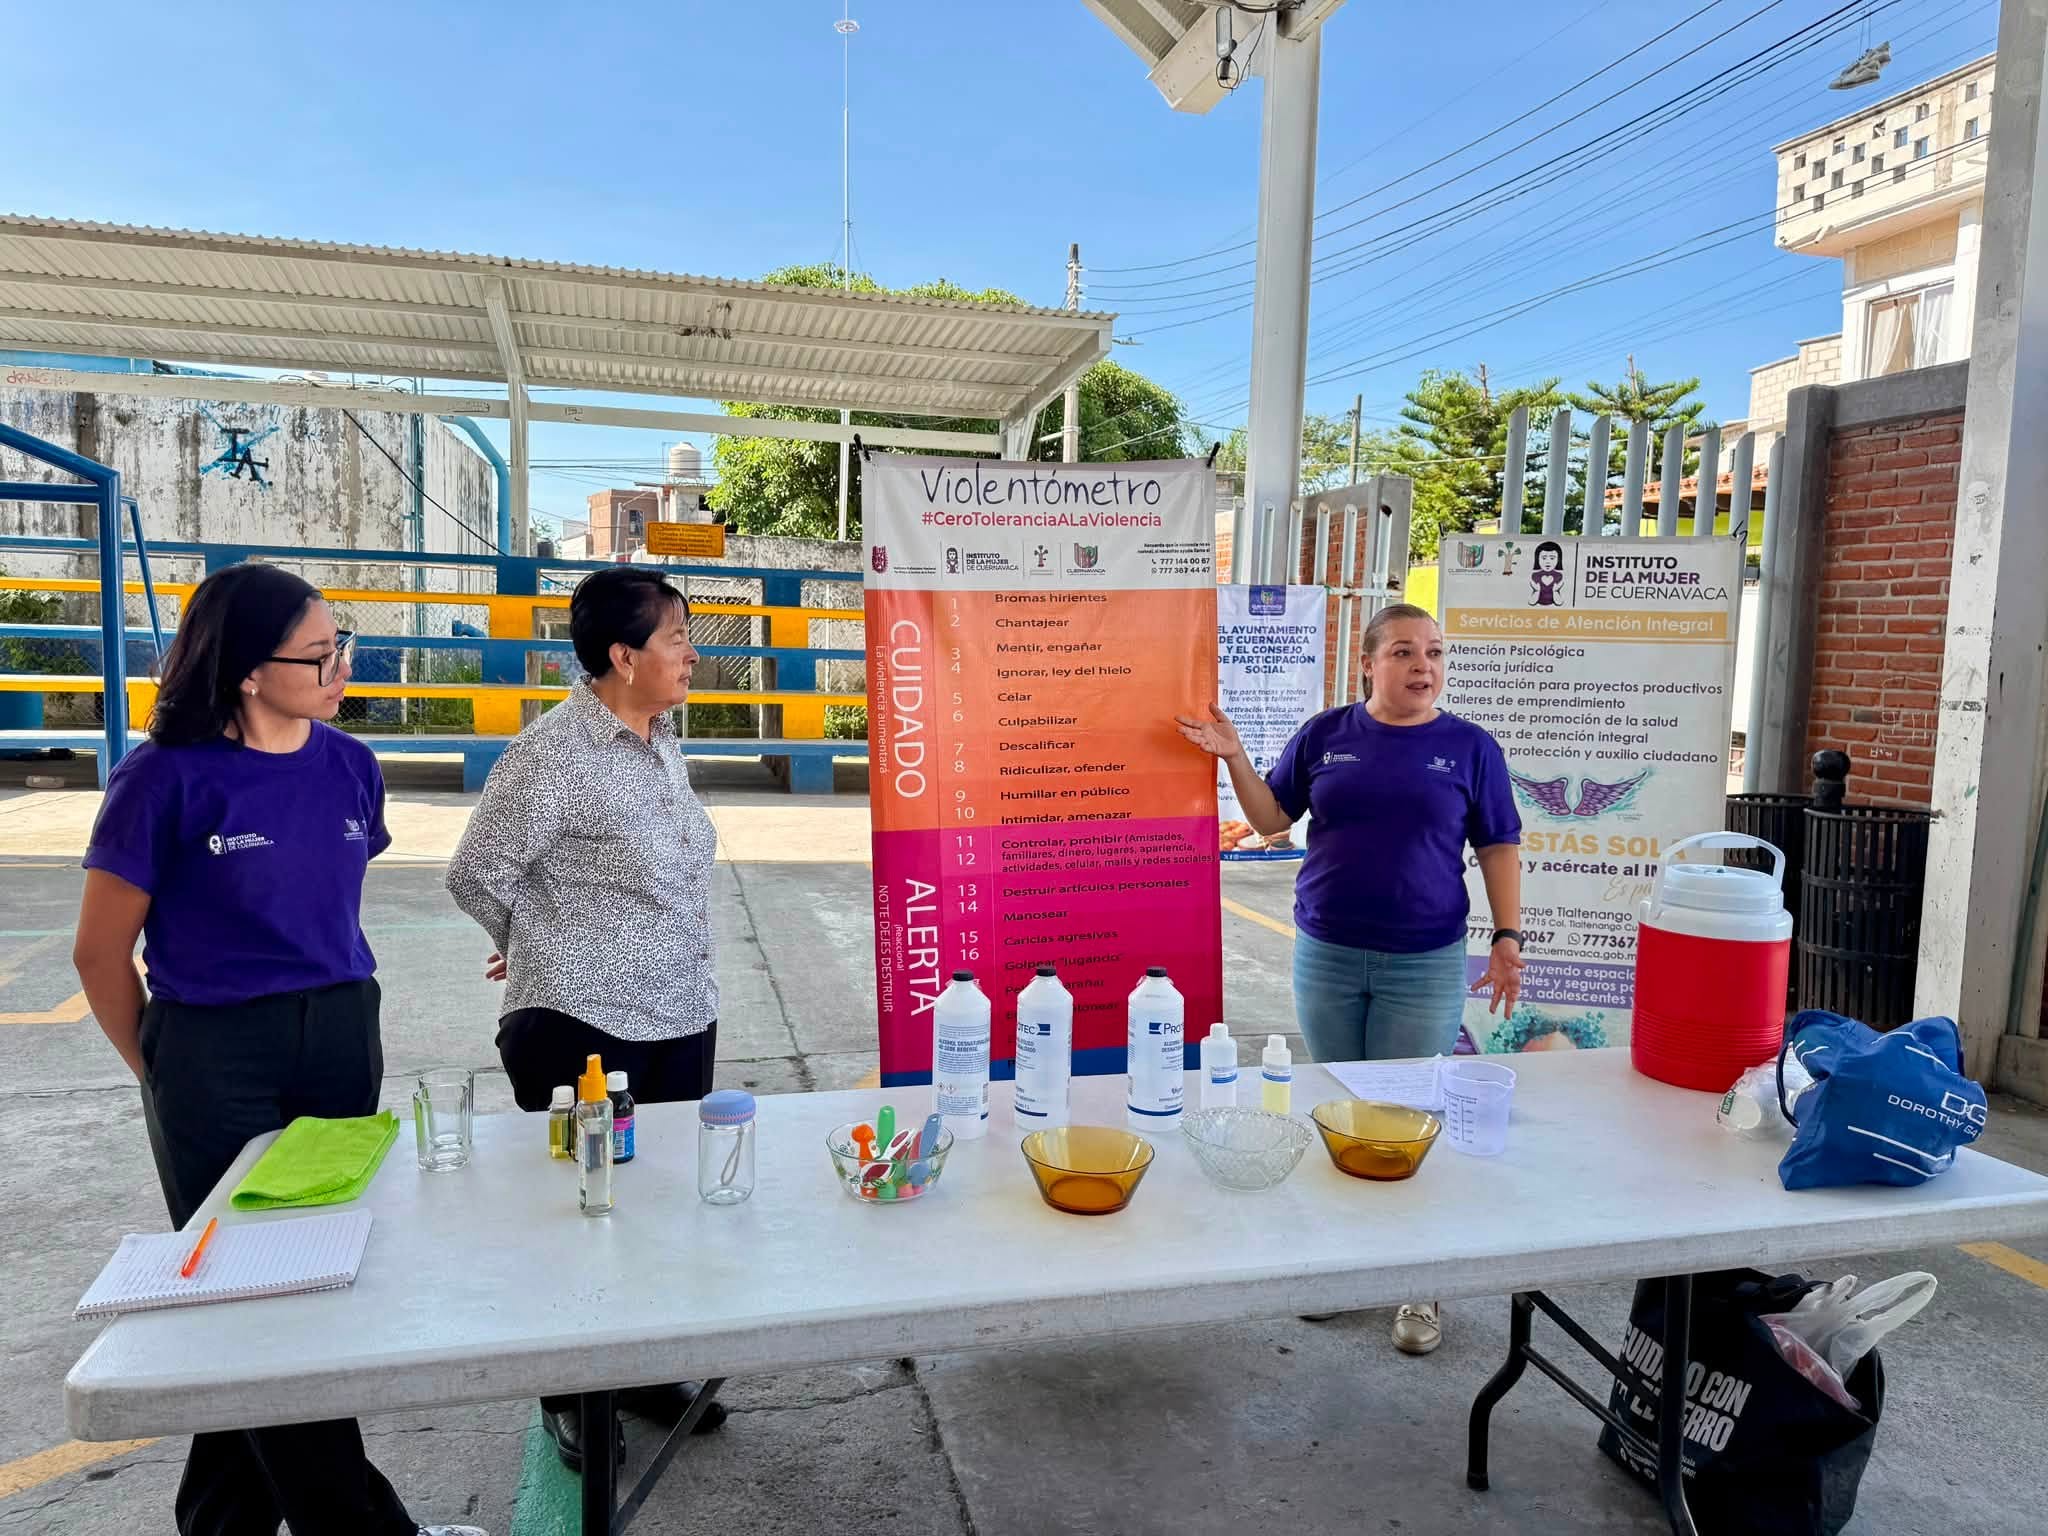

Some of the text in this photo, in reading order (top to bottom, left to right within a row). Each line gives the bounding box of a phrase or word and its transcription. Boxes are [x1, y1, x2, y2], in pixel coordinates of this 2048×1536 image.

[920, 462, 1161, 505] Violentómetro
[921, 511, 1162, 528] #CeroToleranciaALaViolencia
[1586, 555, 1678, 569] INSTITUTO
[1585, 571, 1700, 585] DE LA MUJER
[995, 593, 1107, 603] Bromas hirientes
[1584, 586, 1728, 600] DE CUERNAVACA
[951, 598, 958, 609] 1
[951, 615, 960, 627] 2
[995, 618, 1069, 629] Chantajear
[1459, 613, 1713, 634] Servicios de Atención Integral
[1231, 625, 1317, 634] AYUNTAMIENTO
[1218, 635, 1310, 644] DE CUERNAVACA
[951, 648, 961, 660] 3
[996, 642, 1102, 654] Mentir, engañar
[1226, 645, 1302, 654] Y EL CONSEJO
[1449, 643, 1585, 660] Atención Psicológica
[1232, 653, 1316, 664] PARTICIPACIÓN
[951, 662, 961, 674] 4
[997, 665, 1131, 679] Ignorar, ley del hielo
[1245, 665, 1285, 674] SOCIAL
[1448, 660, 1554, 675] Asesoría jurídica
[876, 659, 887, 711] violencia
[1447, 677, 1723, 695] Capacitación para proyectos productivos
[952, 692, 962, 705] 5
[997, 692, 1032, 702] Celar
[1446, 694, 1625, 710] Talleres de emprendimiento
[890, 620, 926, 798] CUIDADO
[952, 709, 963, 722] 6
[998, 716, 1077, 727] Culpabilizar
[1508, 712, 1526, 722] de
[1530, 713, 1600, 727] promoción
[1604, 714, 1623, 726] de
[1625, 714, 1639, 726] la
[1642, 715, 1678, 728] salud
[1515, 729, 1533, 740] de
[1537, 730, 1595, 742] atención
[1598, 731, 1649, 745] integral
[954, 743, 964, 756] 7
[999, 740, 1075, 751] Descalificar
[1509, 746, 1718, 763] protección y auxilio ciudadano
[954, 760, 965, 773] 8
[1000, 763, 1126, 776] Ridiculizar, ofender
[955, 790, 966, 803] 9
[1000, 789, 1057, 801] Humillar
[1080, 786, 1130, 798] público
[954, 807, 975, 820] 10
[1001, 810, 1132, 825] Intimidar, amenazar
[955, 835, 974, 849] 11
[1001, 831, 1185, 849] Controlar, prohibir (Amistades,
[1002, 848, 1057, 861] familiares,
[1058, 846, 1094, 858] dinero,
[1607, 836, 1687, 860] SOL
[956, 852, 976, 866] 12
[1002, 860, 1061, 873] actividades,
[1065, 858, 1101, 870] celular,
[1104, 857, 1132, 867] mails
[1133, 858, 1140, 868] y
[1142, 855, 1171, 866] redes
[1527, 861, 1537, 873] y
[1542, 859, 1618, 876] acércate
[1623, 863, 1639, 876] al
[957, 883, 977, 897] 13
[1003, 878, 1190, 898] Destruir artículos personales
[959, 900, 978, 914] 14
[1003, 909, 1069, 922] Manosear
[1519, 907, 1632, 923] arque Tlaltenango
[1548, 919, 1566, 928] Col.
[1569, 920, 1622, 932] Tlaltenango
[959, 931, 979, 945] 15
[1004, 930, 1118, 946] Caricias agresivas
[878, 885, 893, 1013] NO TE DEJES DESTRUIR
[905, 878, 941, 1016] ALERTA
[960, 948, 980, 962] 16
[1553, 979, 1561, 989] y
[1565, 979, 1616, 992] seguros
[1536, 989, 1626, 1005] adolescentes
[1887, 1094, 1964, 1129] DOROTHY
[1700, 1371, 1752, 1417] CON
